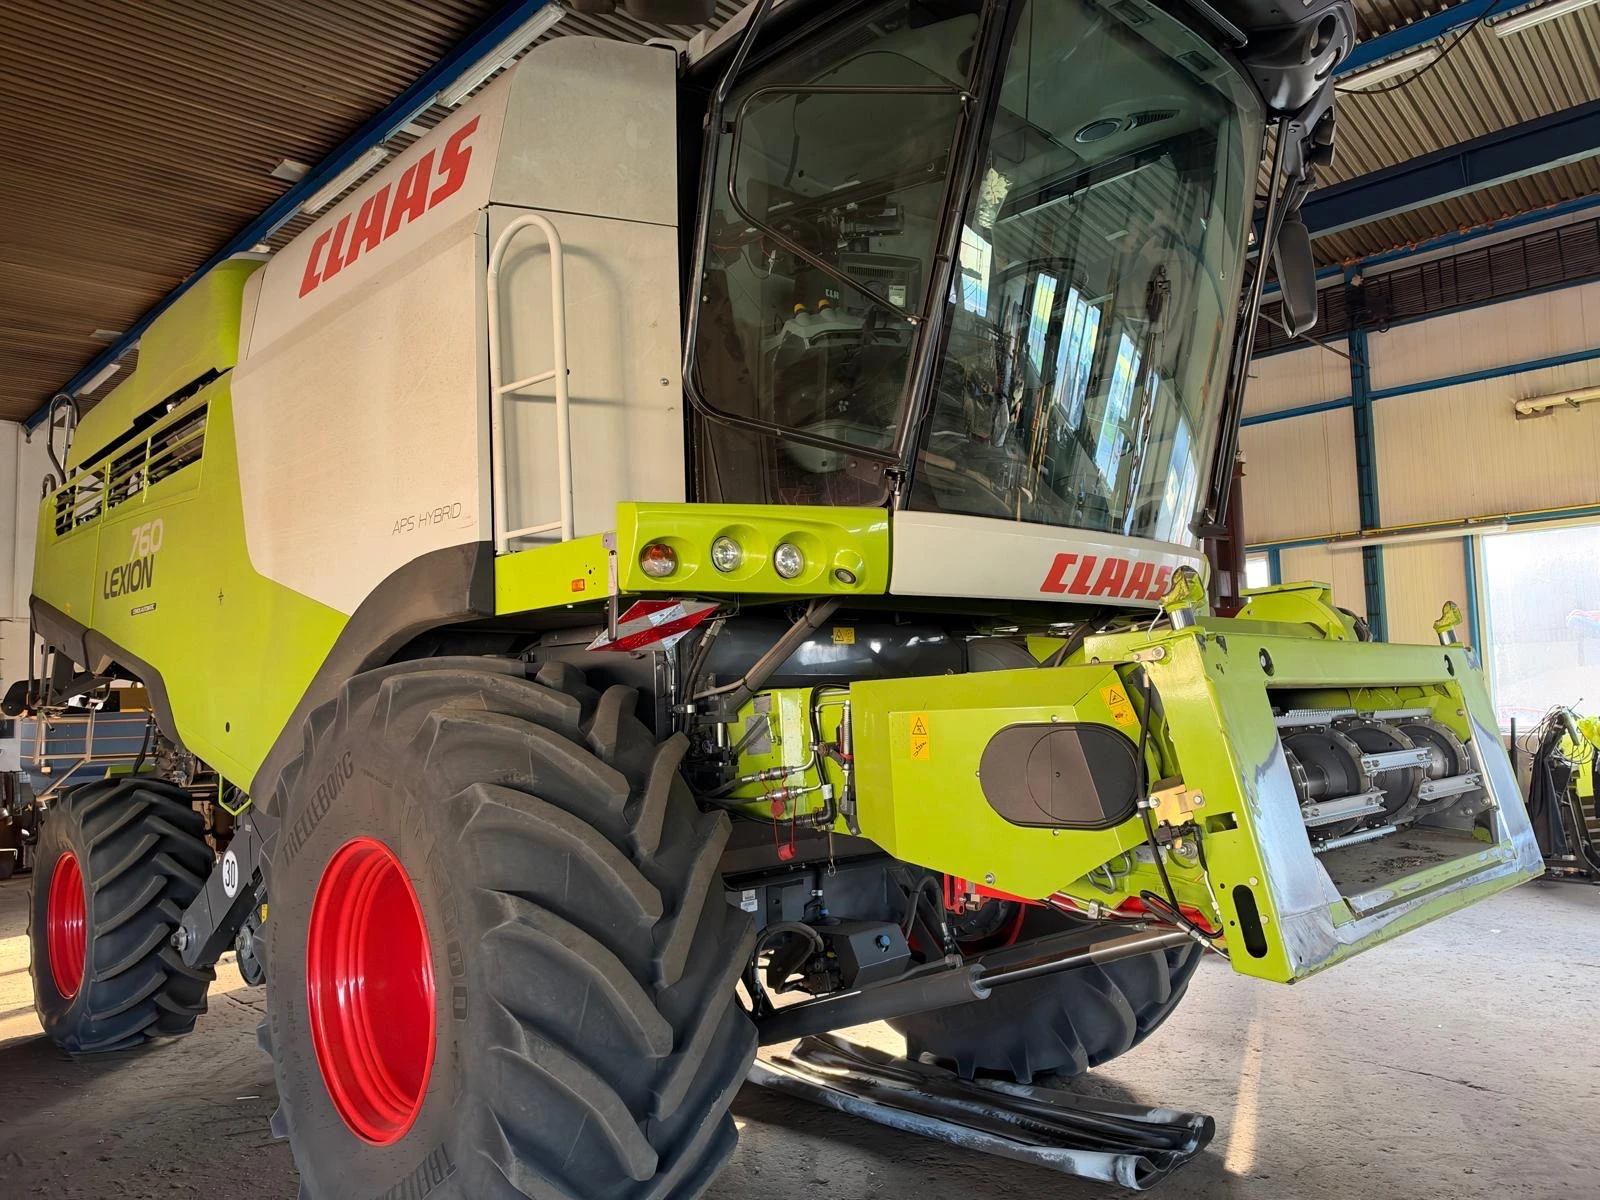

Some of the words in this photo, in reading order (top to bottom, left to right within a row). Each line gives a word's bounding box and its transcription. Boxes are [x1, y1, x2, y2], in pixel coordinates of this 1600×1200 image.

[298, 114, 481, 299] CLAAS
[130, 518, 163, 561] 760
[392, 515, 415, 536] APS
[418, 502, 462, 528] HYBRID
[103, 553, 154, 600] LEXION
[1039, 553, 1173, 600] CLAAS
[283, 751, 354, 867] TRELLEBORG
[225, 859, 236, 889] 30
